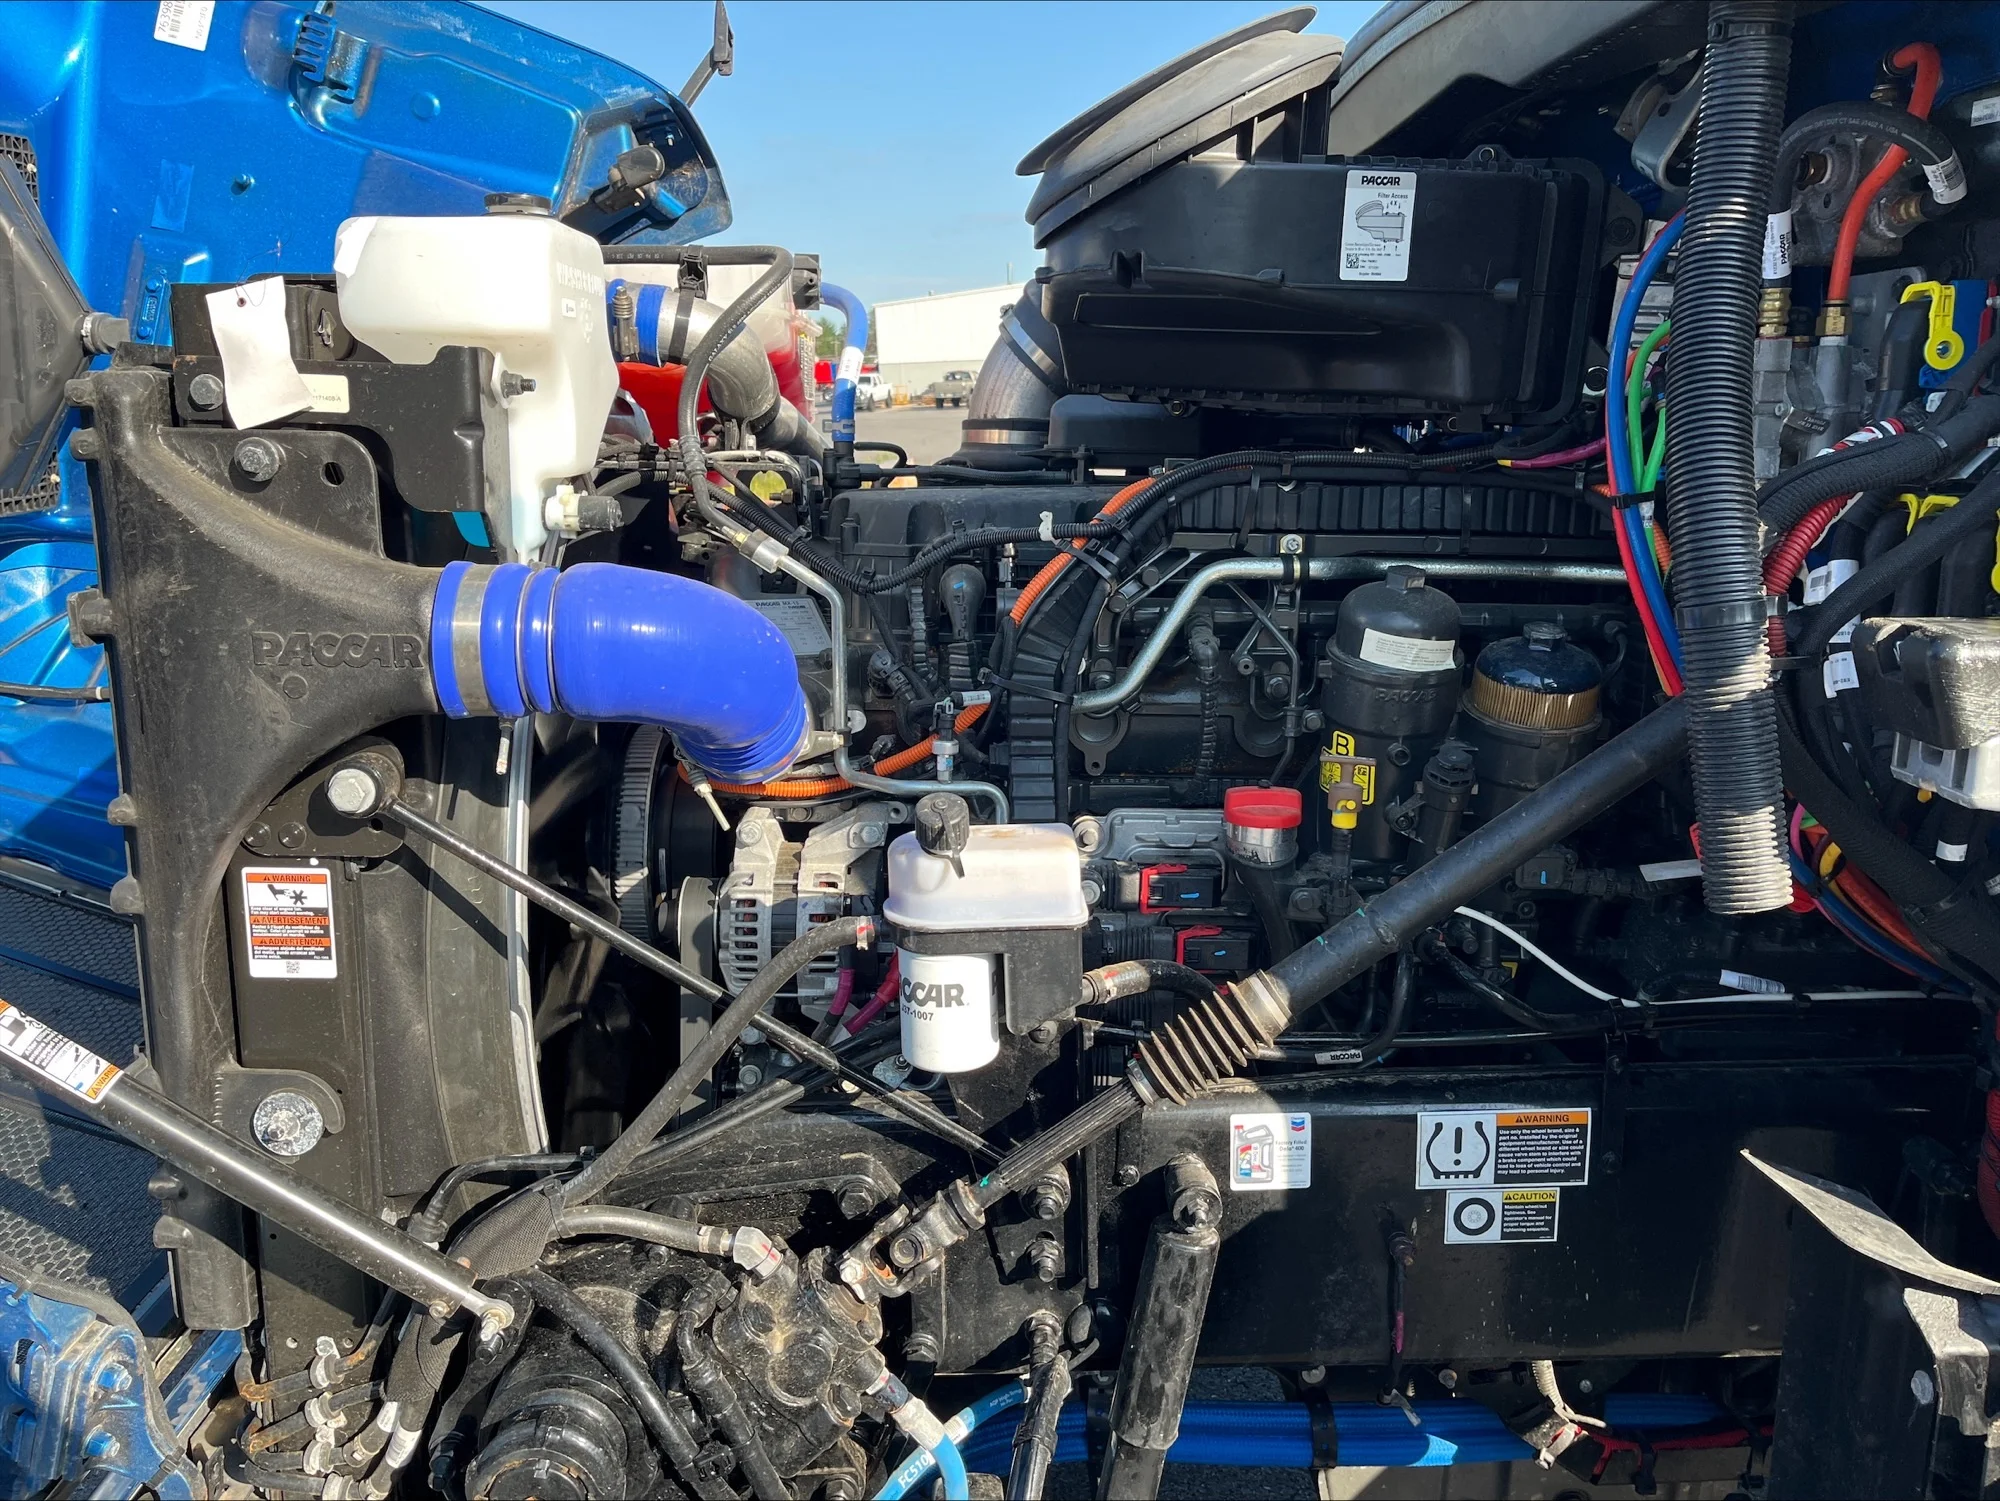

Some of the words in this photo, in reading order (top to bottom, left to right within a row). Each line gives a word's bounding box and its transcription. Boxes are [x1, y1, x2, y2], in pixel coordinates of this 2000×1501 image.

[1361, 176, 1400, 186] PACCAR
[251, 630, 424, 670] PACCAR
[1336, 734, 1349, 756] B
[902, 977, 964, 1008] CCAR
[1330, 1052, 1361, 1061] PACCAR
[898, 1454, 929, 1489] FC510
